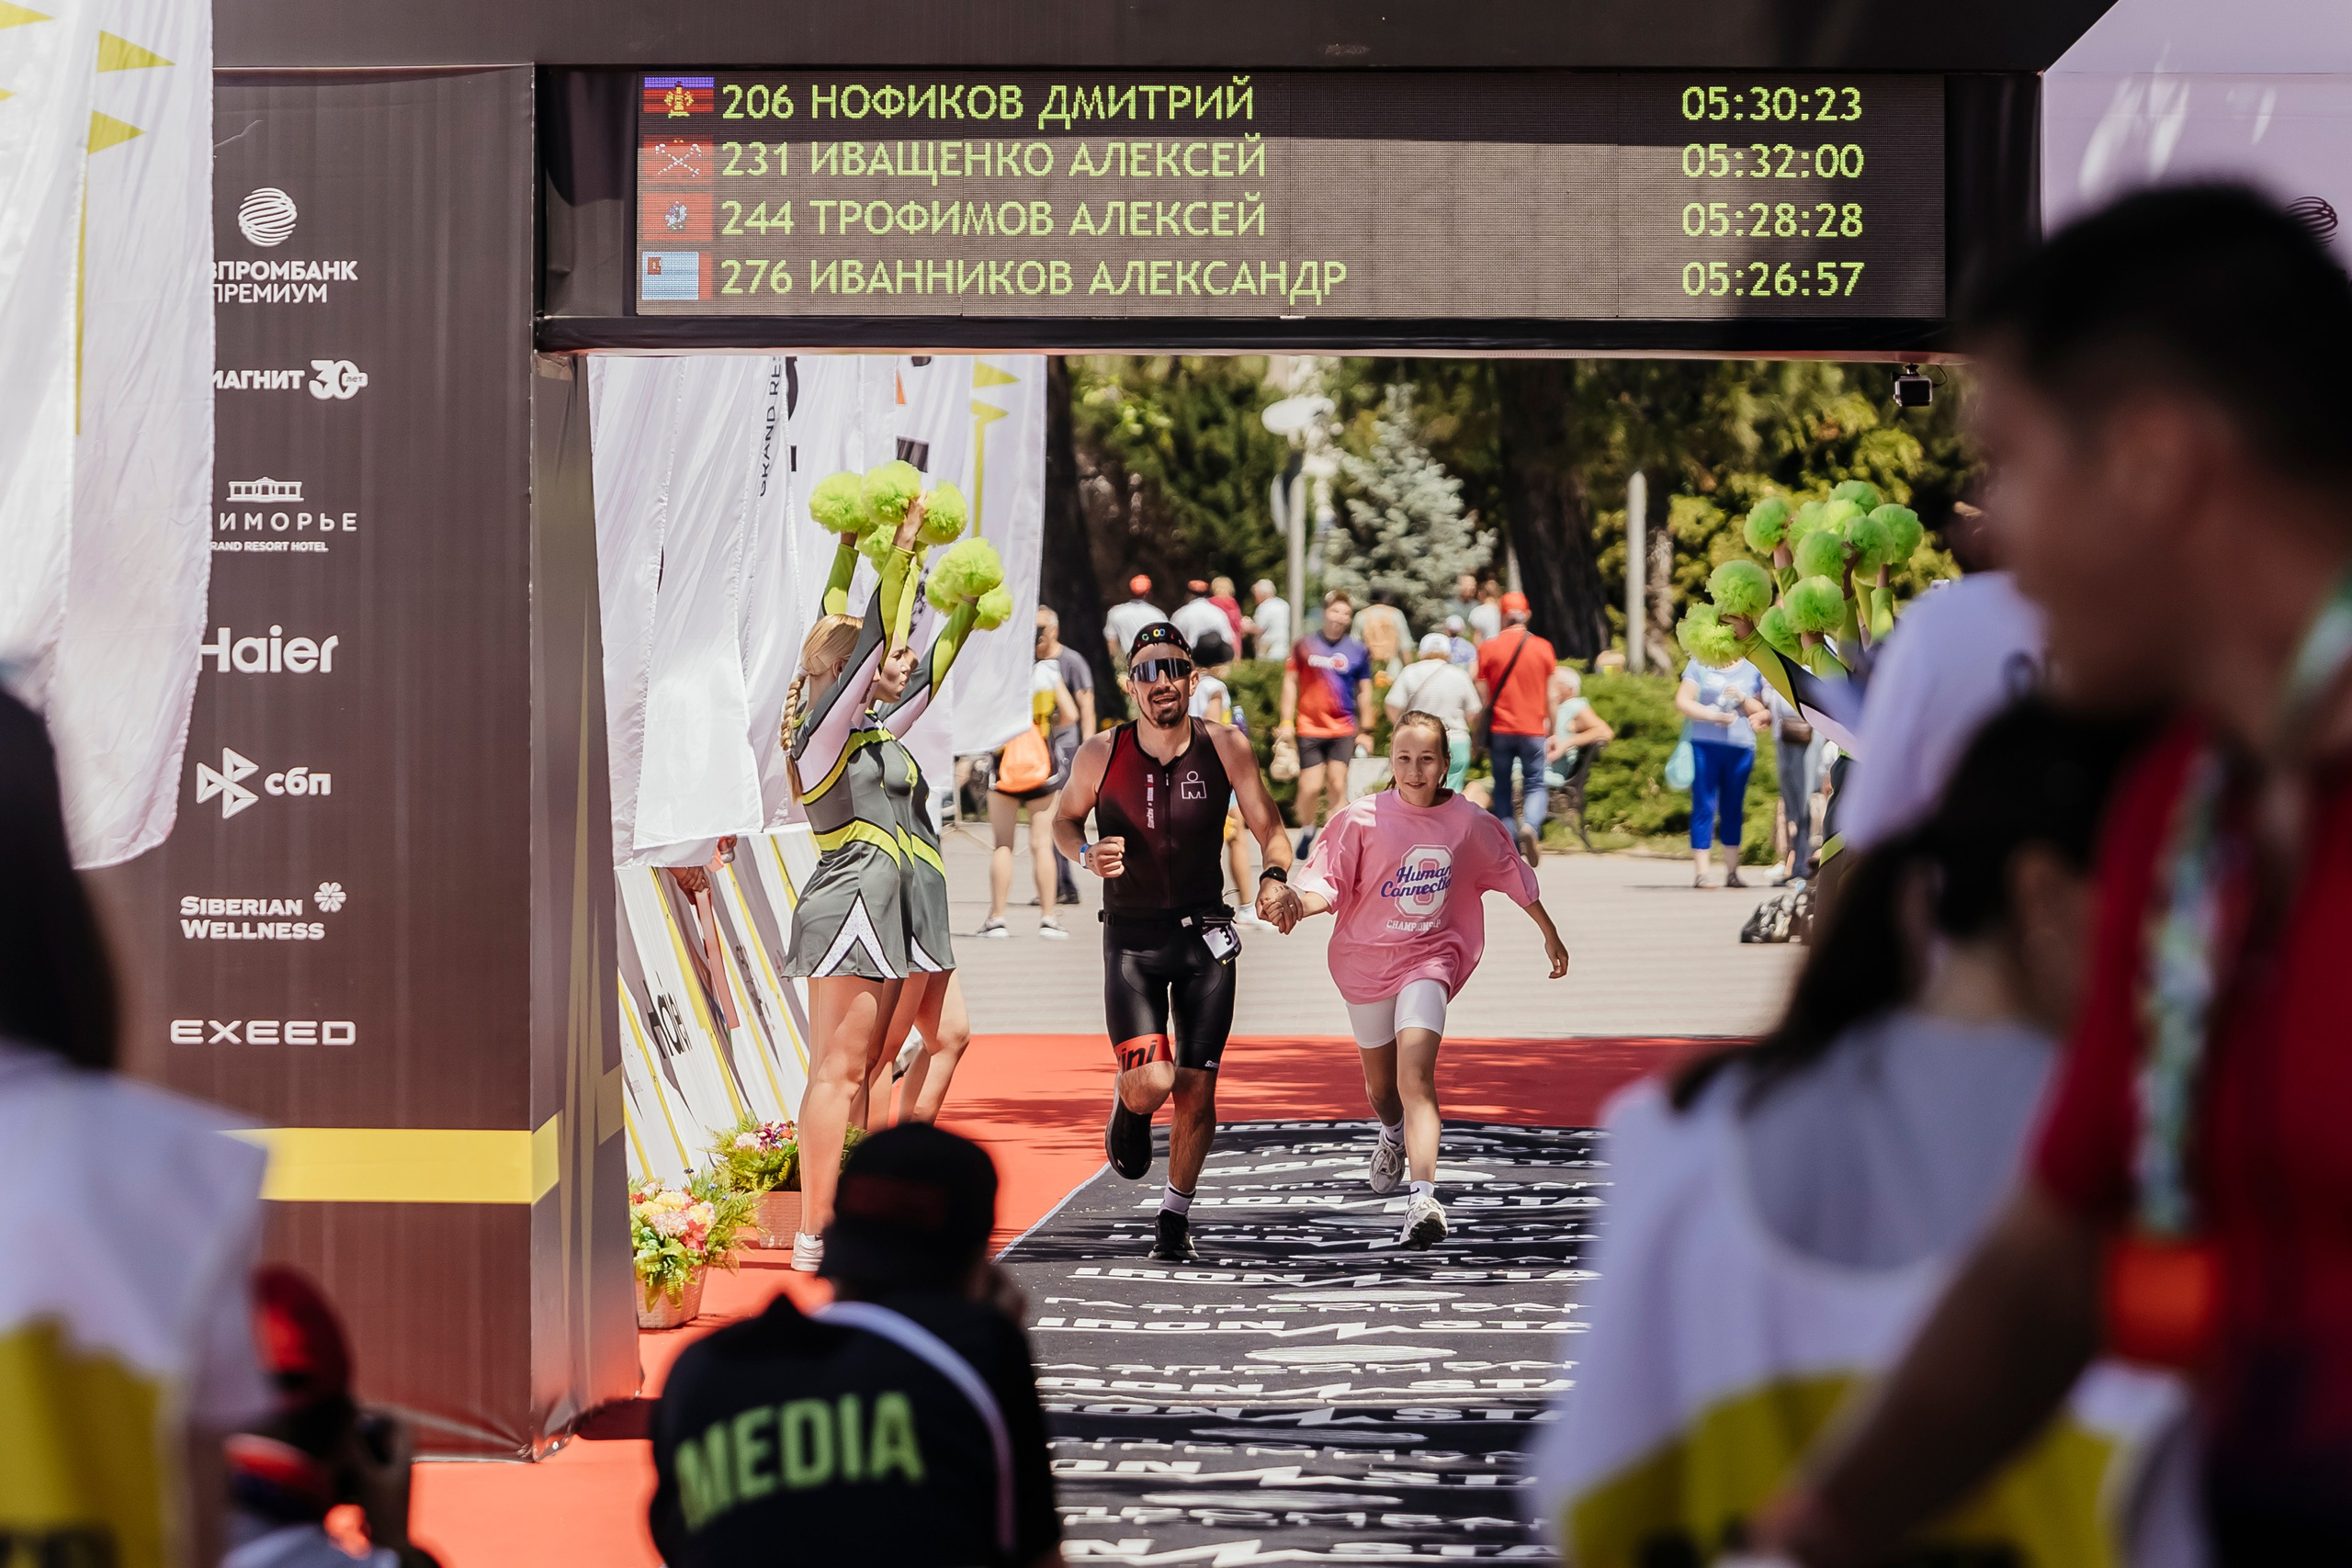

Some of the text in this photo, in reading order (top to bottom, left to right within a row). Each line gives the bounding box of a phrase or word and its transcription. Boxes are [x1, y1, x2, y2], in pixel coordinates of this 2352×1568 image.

[722, 75, 1862, 130] 206 НОФИКОВ ДМИТРИЙ 05:30:23
[722, 133, 1864, 186] 231 ИВАЩЕНКО АЛЕКСЕЙ 05:32:00
[722, 193, 1863, 238] 244 ТРОФИМОВ АЛЕКСЕЙ 05:28:28
[721, 260, 1865, 306] 276 ИВАННИКОВ АЛЕКСАНДР 05:26:57
[243, 541, 290, 552] RESORT
[290, 541, 329, 552] HOTEL
[198, 625, 339, 673] Haier
[264, 766, 332, 795] сбп
[1396, 865, 1452, 884] Human
[170, 1020, 356, 1045] EXEED
[1075, 1268, 1306, 1282] IRON
[1037, 1317, 1286, 1330] IRON
[674, 1392, 924, 1531] MEDIA
